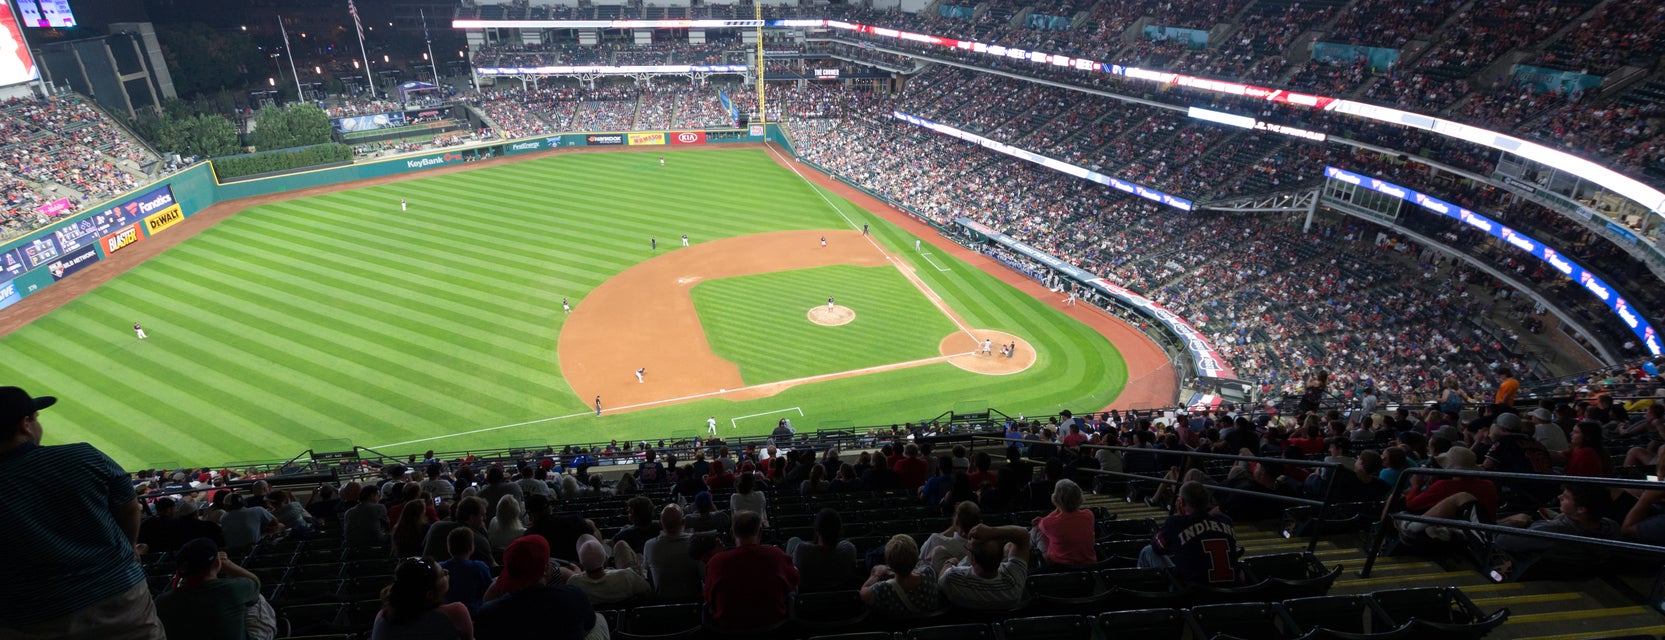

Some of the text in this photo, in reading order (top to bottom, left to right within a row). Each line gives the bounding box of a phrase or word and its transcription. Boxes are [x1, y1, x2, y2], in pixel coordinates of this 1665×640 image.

[407, 156, 444, 169] KeyBank
[138, 194, 172, 214] Fanatics
[108, 227, 138, 254] BLASTER
